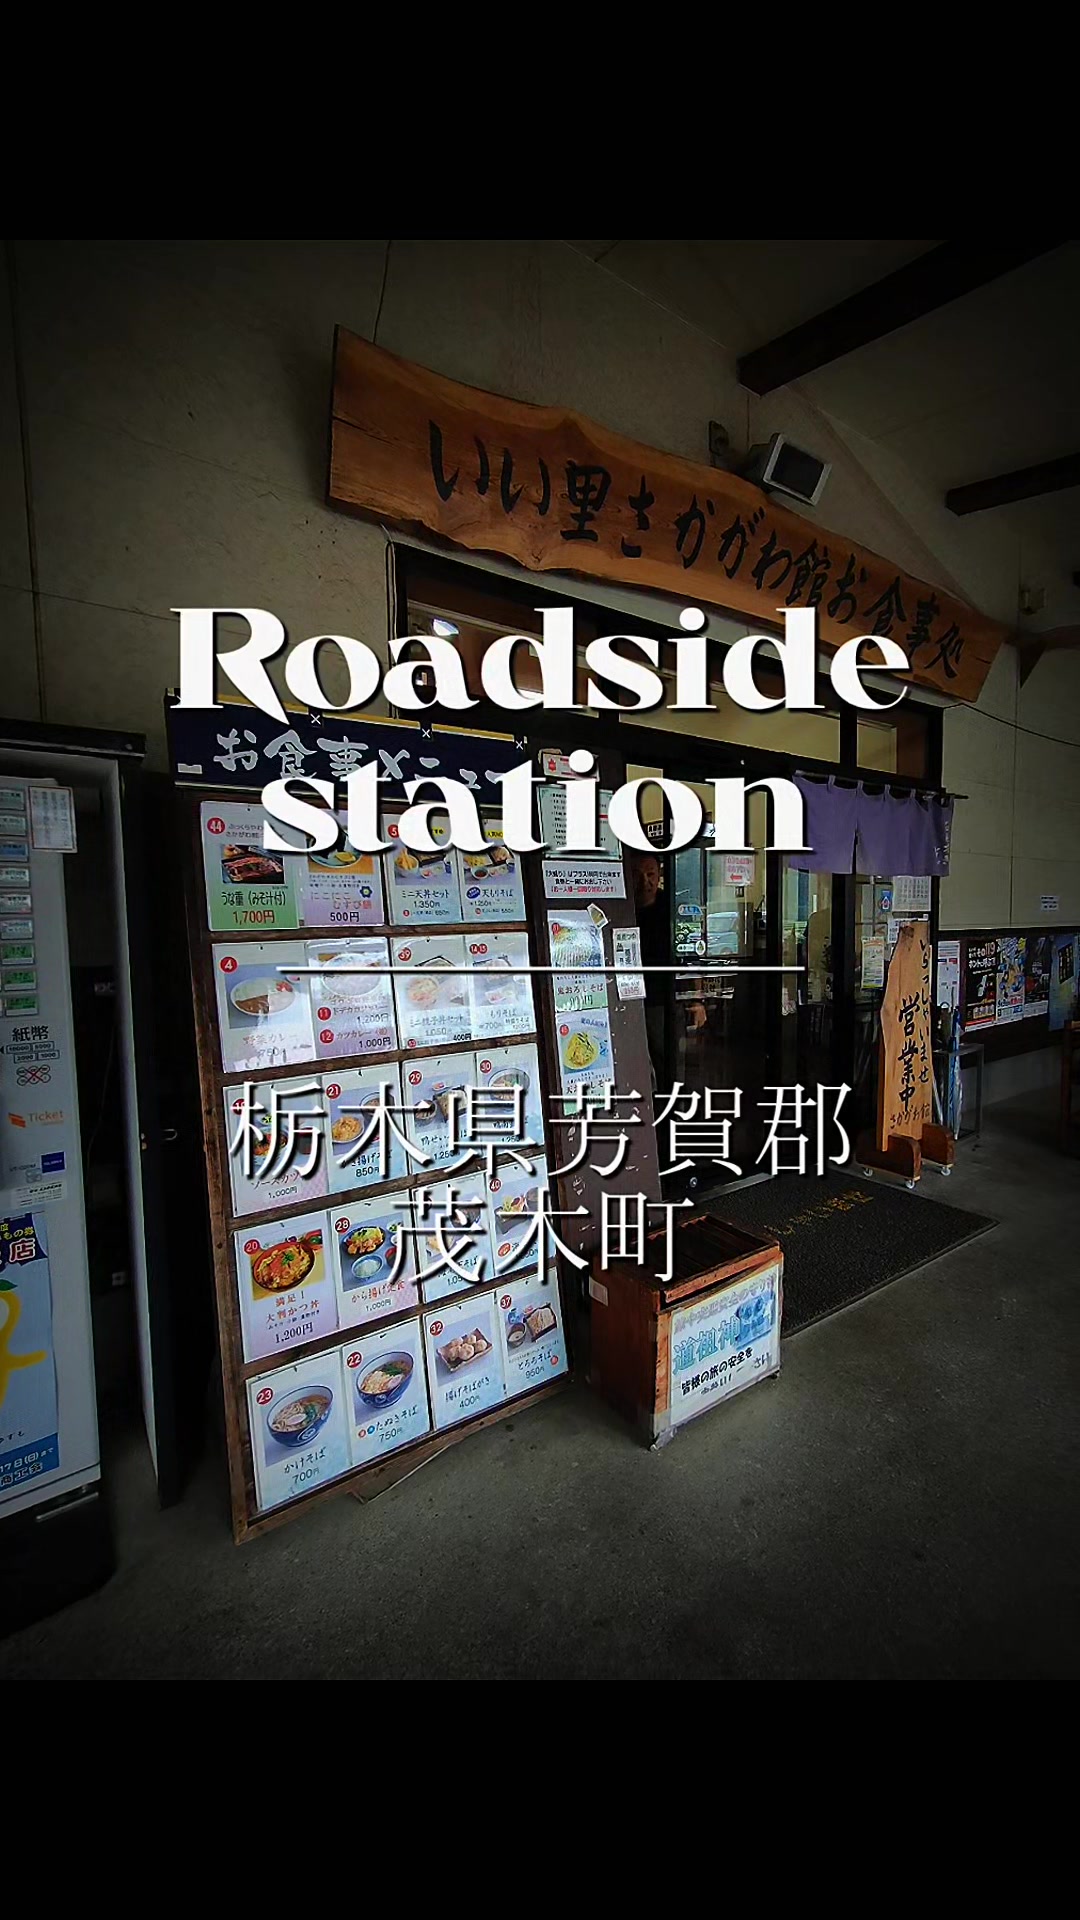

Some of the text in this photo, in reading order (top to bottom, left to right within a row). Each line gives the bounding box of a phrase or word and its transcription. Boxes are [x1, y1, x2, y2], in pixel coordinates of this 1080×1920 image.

[429, 419, 964, 678] いい里さかがわ館お食事処
[210, 820, 222, 832] 44
[233, 910, 275, 925] 1,700円
[330, 911, 360, 923] 500円
[224, 960, 233, 970] 4
[320, 1008, 329, 1018] 11
[918, 938, 930, 1083] いらっしゃいませ
[12, 1025, 49, 1043] 紙幣
[321, 1032, 332, 1042] 12
[358, 1037, 392, 1049] 1,000円
[898, 992, 920, 1112] 営業中
[480, 1062, 491, 1071] 30
[410, 1072, 421, 1083] 29
[329, 1086, 339, 1096] 21
[28, 1109, 64, 1122] Ticket
[268, 1186, 298, 1199] 1,000円
[336, 1220, 348, 1231] 28
[246, 1243, 258, 1252] 20
[365, 1298, 392, 1312] 1,000円
[501, 1296, 511, 1307] 37
[275, 1321, 313, 1344] 1,200円
[431, 1323, 442, 1334] 32
[348, 1354, 361, 1367] 22
[681, 1347, 753, 1396] 皆様の旅の安全を
[258, 1390, 271, 1402] 23
[376, 1404, 419, 1432] たぬきそば
[378, 1427, 403, 1443] 750円
[284, 1446, 327, 1474] かけそば
[292, 1466, 320, 1485] 700円
